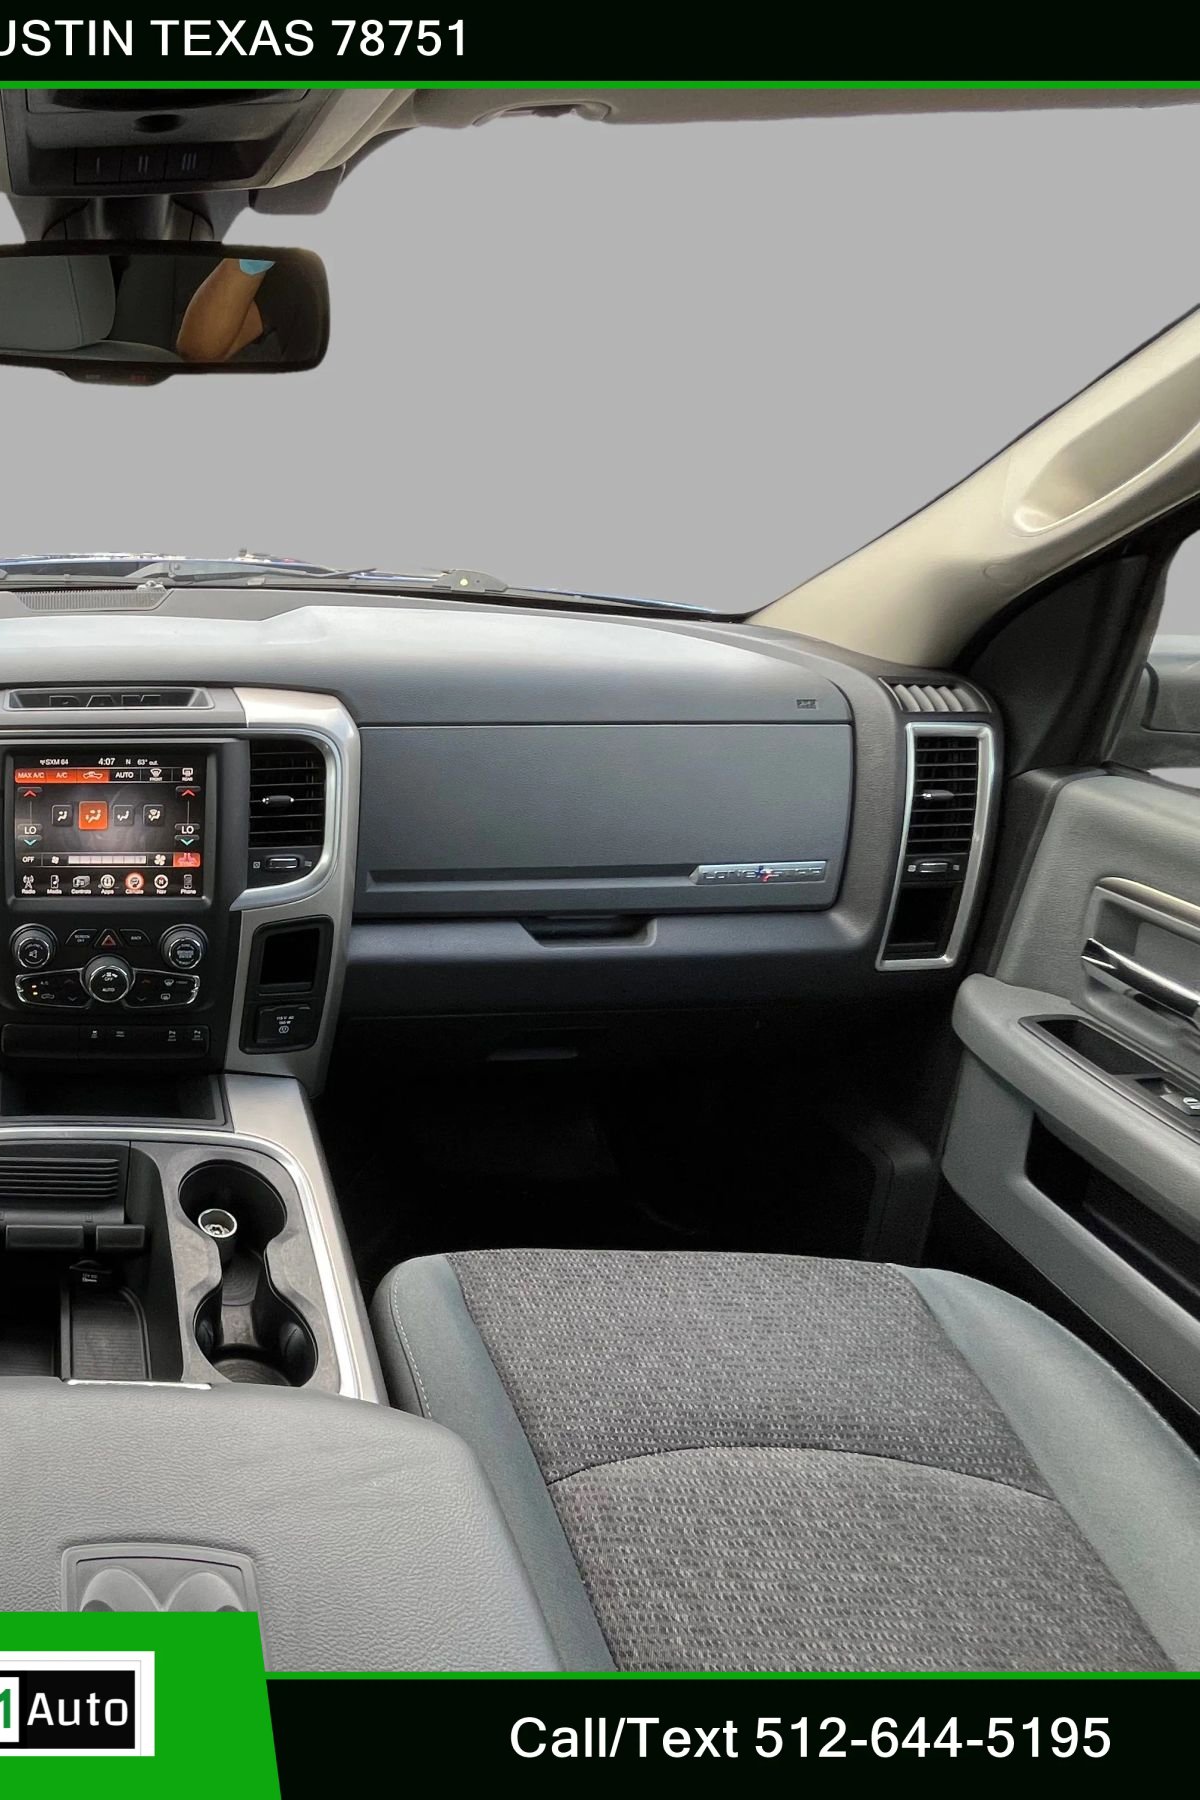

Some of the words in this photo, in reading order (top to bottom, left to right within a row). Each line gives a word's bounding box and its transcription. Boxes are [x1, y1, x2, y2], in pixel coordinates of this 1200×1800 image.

[98, 757, 116, 766] 4:07
[115, 771, 134, 779] AUTO
[24, 826, 37, 835] LO
[181, 825, 195, 835] LO
